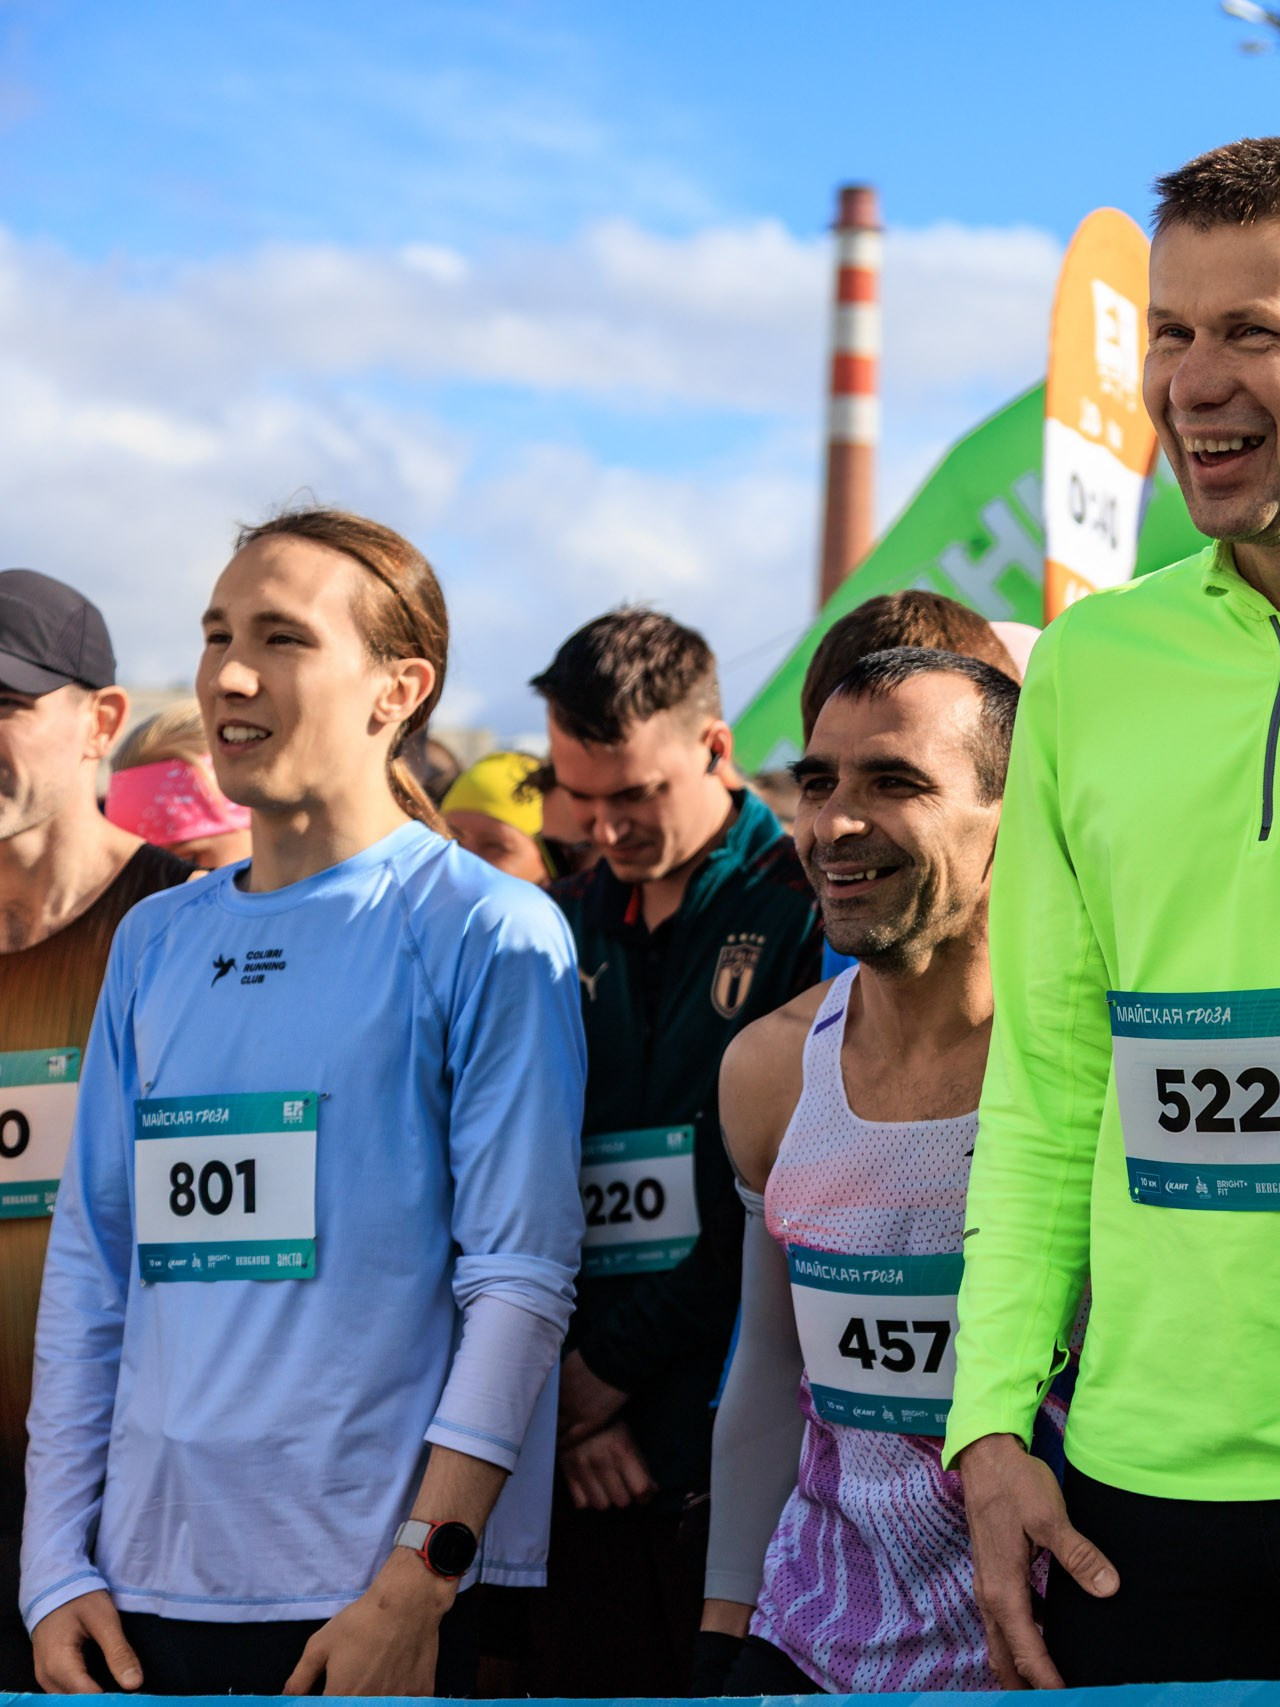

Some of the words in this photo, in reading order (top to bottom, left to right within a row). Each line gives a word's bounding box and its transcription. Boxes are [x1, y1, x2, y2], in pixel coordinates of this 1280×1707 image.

[246, 949, 284, 960] COLIBRI
[243, 961, 286, 973] RUNNING
[240, 974, 265, 985] CLUB
[1117, 1003, 1184, 1024] МАЙСКАЯ
[142, 1109, 194, 1127] МАЙСКАЯ
[169, 1158, 256, 1217] 801
[1217, 1188, 1229, 1196] FIT
[584, 1178, 665, 1227] 220
[795, 1259, 860, 1282] МАЙСКАЯ
[838, 1317, 951, 1373] 457
